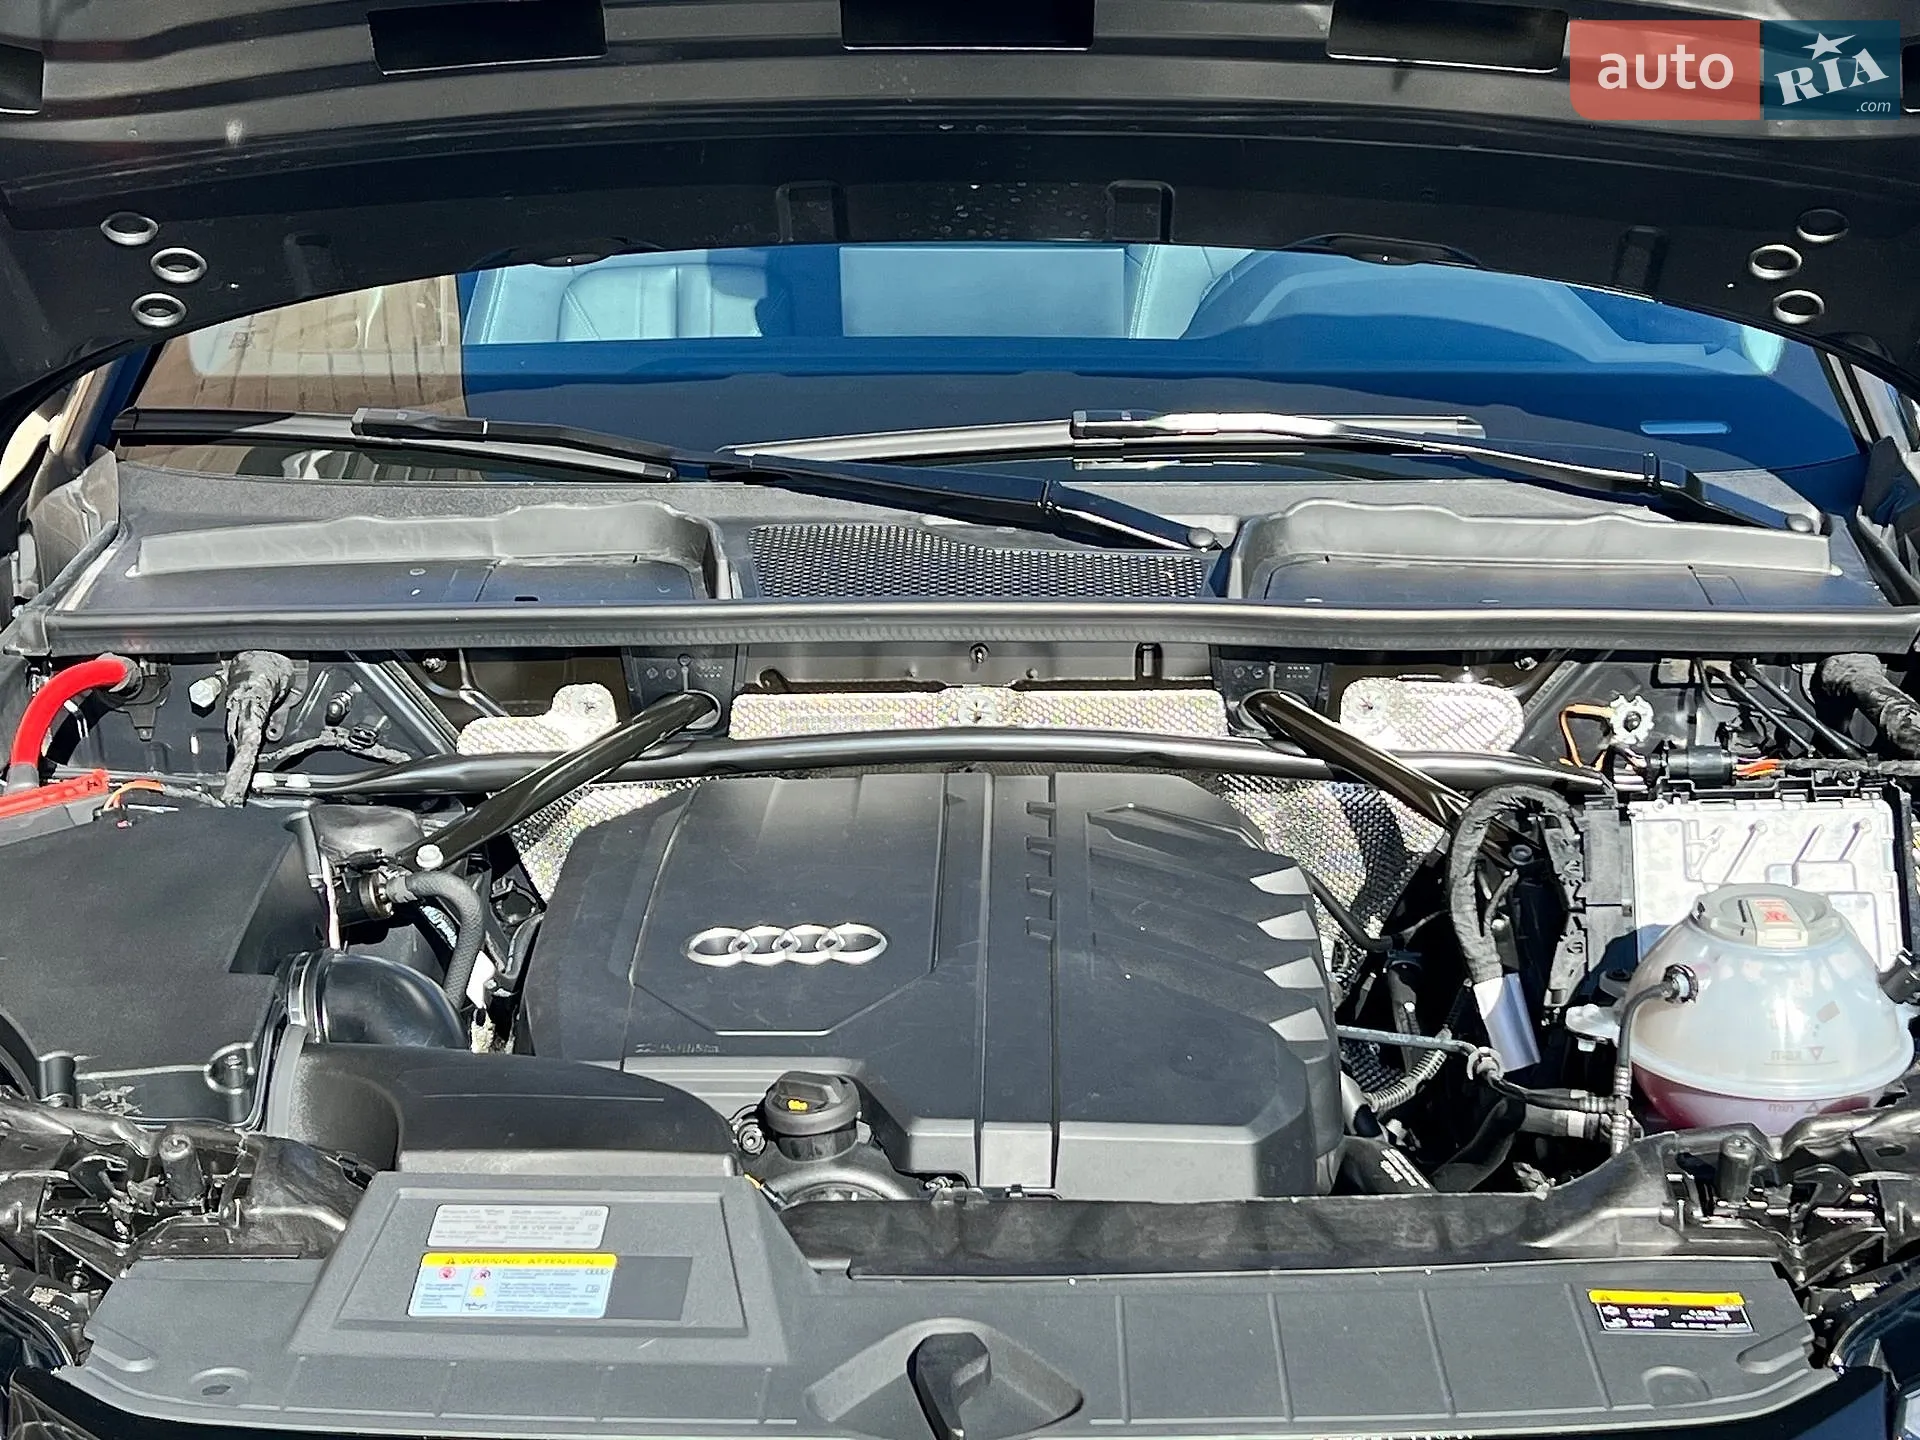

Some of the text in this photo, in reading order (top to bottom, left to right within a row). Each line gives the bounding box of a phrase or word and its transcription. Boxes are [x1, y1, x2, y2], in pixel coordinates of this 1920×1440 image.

[1770, 1050, 1802, 1061] max
[1768, 1103, 1794, 1113] min
[461, 1257, 595, 1266] WARNING ATTENTION
